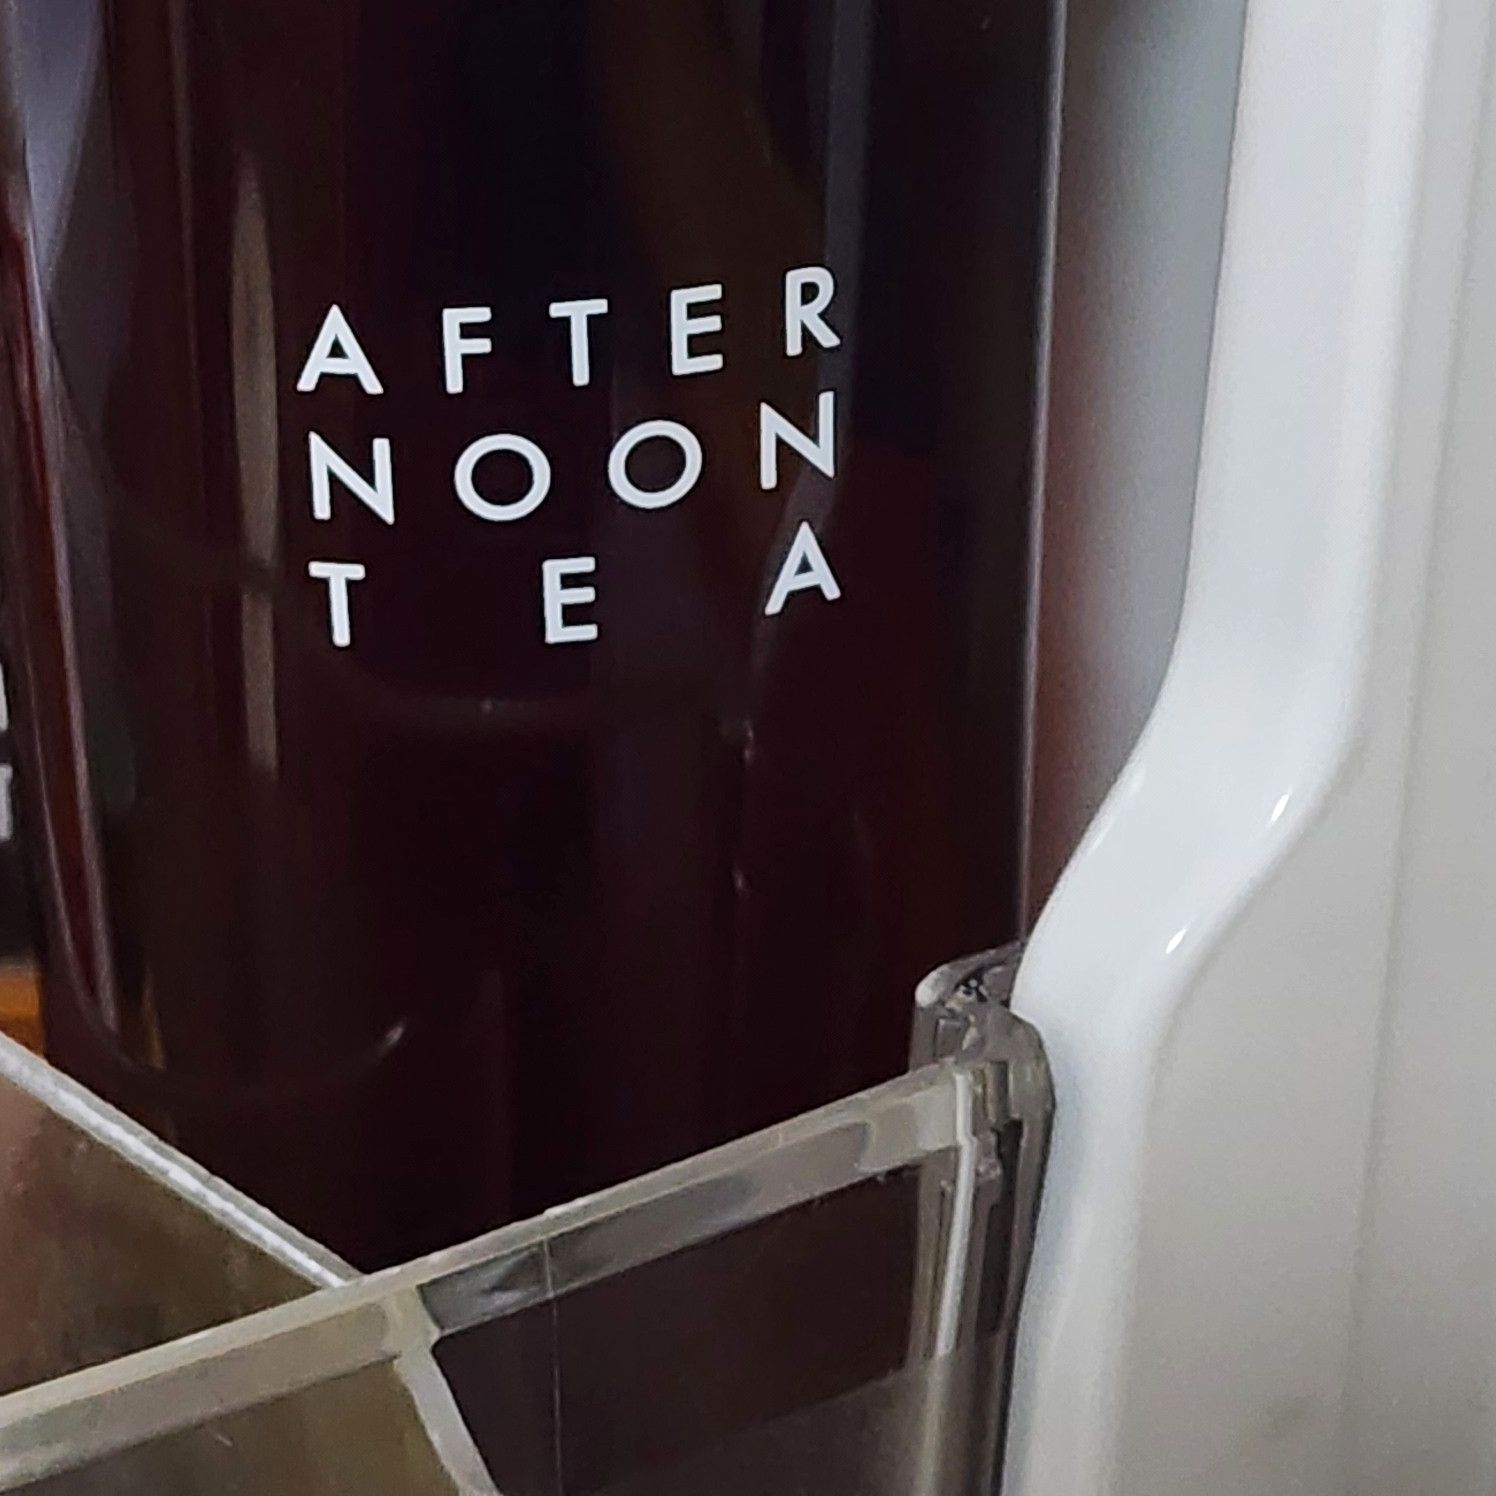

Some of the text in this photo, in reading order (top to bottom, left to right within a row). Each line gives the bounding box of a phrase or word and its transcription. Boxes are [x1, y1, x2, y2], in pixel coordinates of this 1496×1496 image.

[297, 266, 841, 395] AFTER
[308, 390, 836, 525] NOON
[308, 521, 841, 646] TEA
